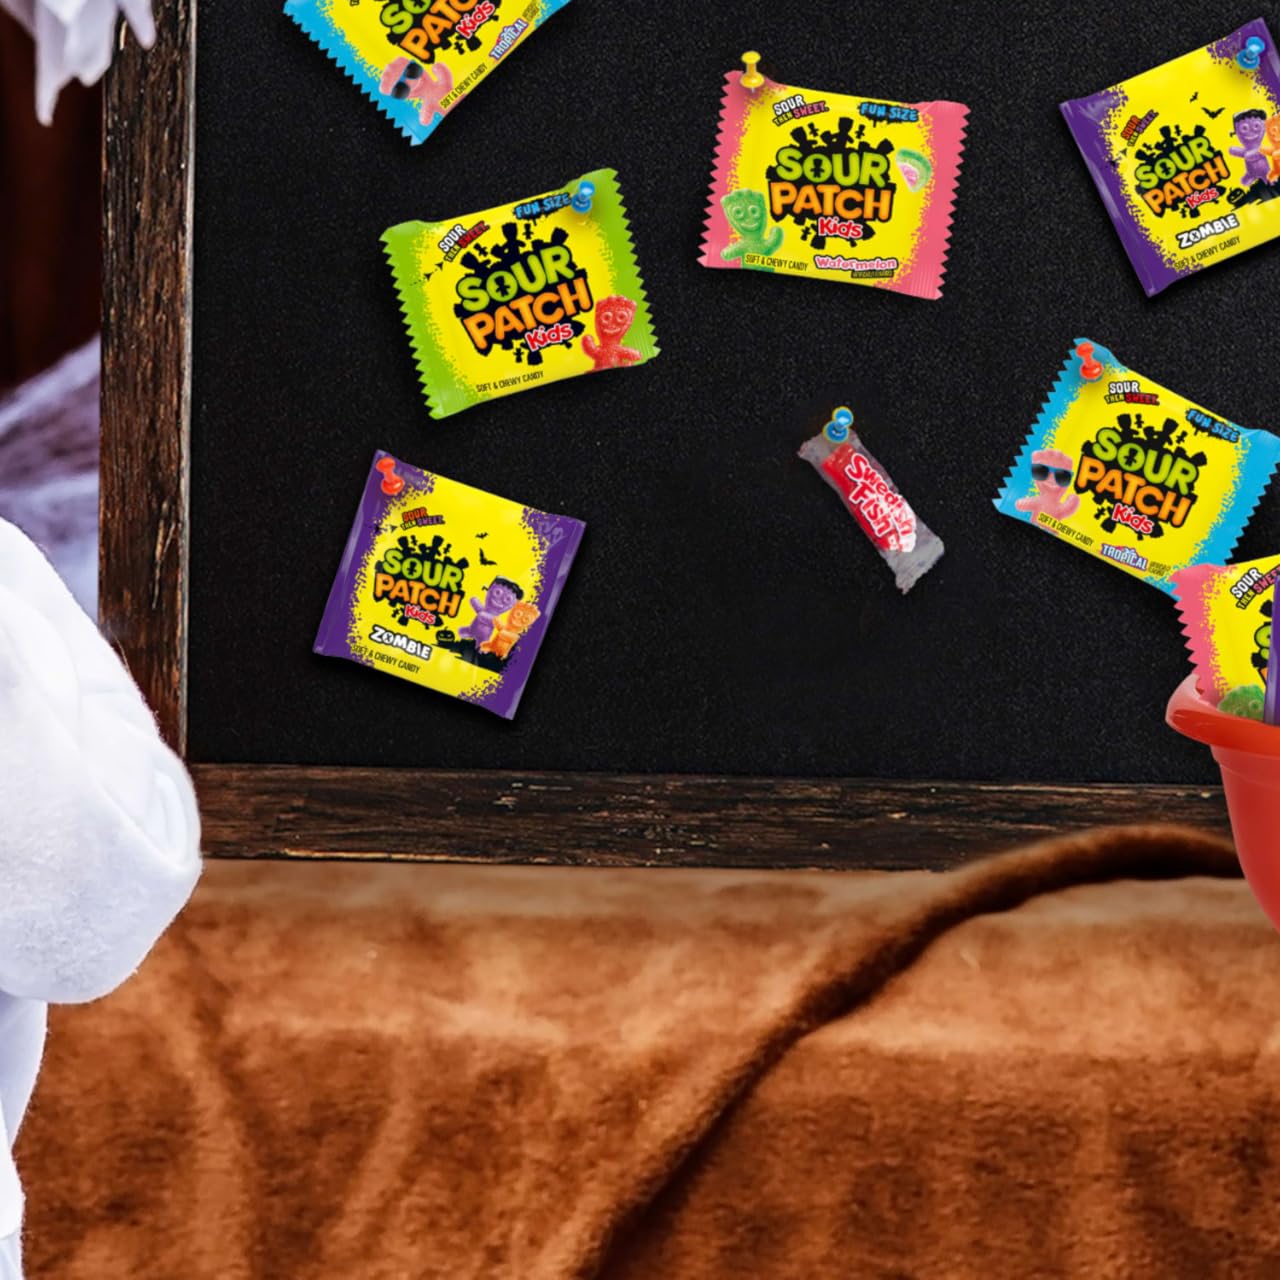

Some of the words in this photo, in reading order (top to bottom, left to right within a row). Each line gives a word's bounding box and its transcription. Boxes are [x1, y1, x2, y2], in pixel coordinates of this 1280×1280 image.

[456, 0, 495, 39] Kids
[490, 19, 528, 60] TROPICAL
[773, 95, 804, 115] SOUR
[860, 103, 886, 117] FUN
[888, 108, 918, 121] SIZE
[1121, 115, 1140, 140] SOUR
[775, 147, 888, 187] SOUR
[1135, 137, 1215, 189] SOUR
[769, 182, 892, 220] PATCH
[1143, 156, 1229, 214] PATCH
[1185, 188, 1219, 209] Kids
[515, 201, 540, 219] FUN
[542, 193, 570, 212] SIZE
[439, 224, 466, 253] SOUR
[818, 217, 863, 239] Kids
[1176, 213, 1240, 250] ZOMBIE
[457, 246, 575, 311] SOUR
[814, 254, 898, 271] Watermelon
[463, 277, 591, 350] PATCH
[525, 322, 574, 352] Kids
[1109, 380, 1140, 394] SOUR
[1187, 409, 1212, 428] FUN
[1211, 422, 1240, 443] SIZE
[1093, 428, 1197, 495] SOUR
[845, 453, 915, 536] Swedish
[1076, 455, 1193, 526] PATCH
[402, 507, 427, 523] SOUR
[849, 481, 893, 538] Fish
[1112, 503, 1154, 534] Kids
[382, 550, 462, 591] SOUR
[1101, 543, 1148, 571] TROPICAL
[375, 574, 462, 616] PATCH
[1231, 568, 1262, 599] SOUR
[404, 603, 436, 625] Kids
[369, 624, 432, 660] ZOMBIE
